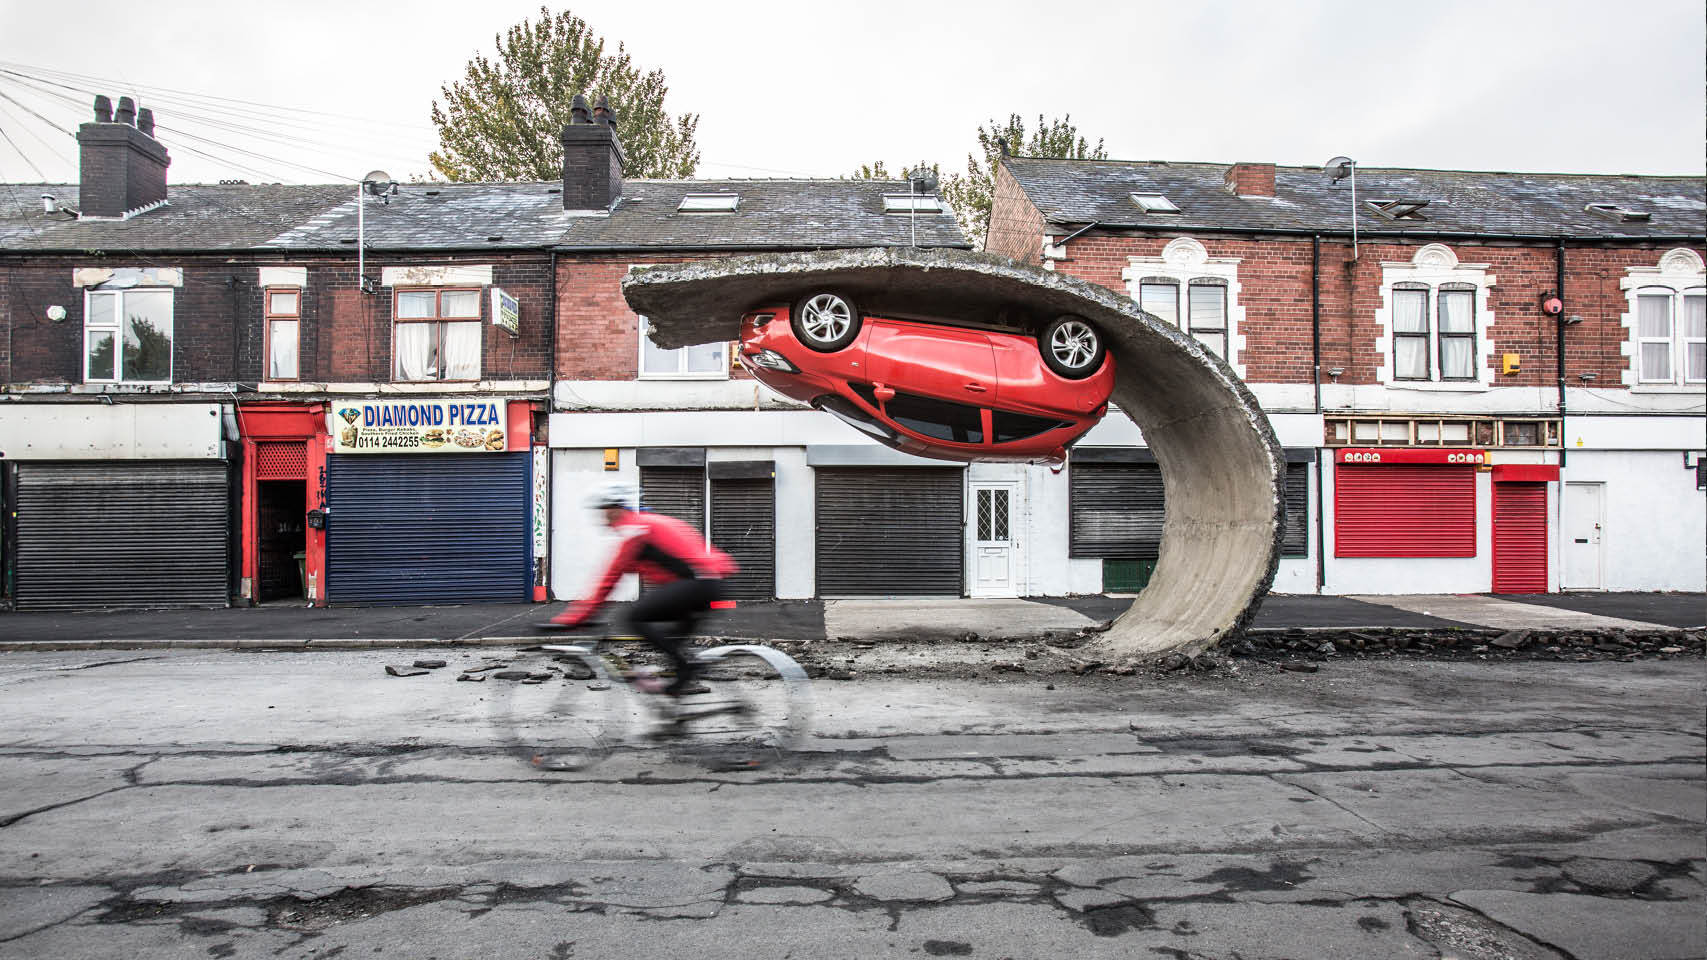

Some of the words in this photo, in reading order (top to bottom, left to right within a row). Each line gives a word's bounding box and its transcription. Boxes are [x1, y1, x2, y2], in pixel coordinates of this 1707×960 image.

[363, 404, 444, 427] DIAMOND
[448, 403, 500, 426] PIZZA
[359, 436, 379, 448] 0114
[382, 436, 419, 447] 2442255
